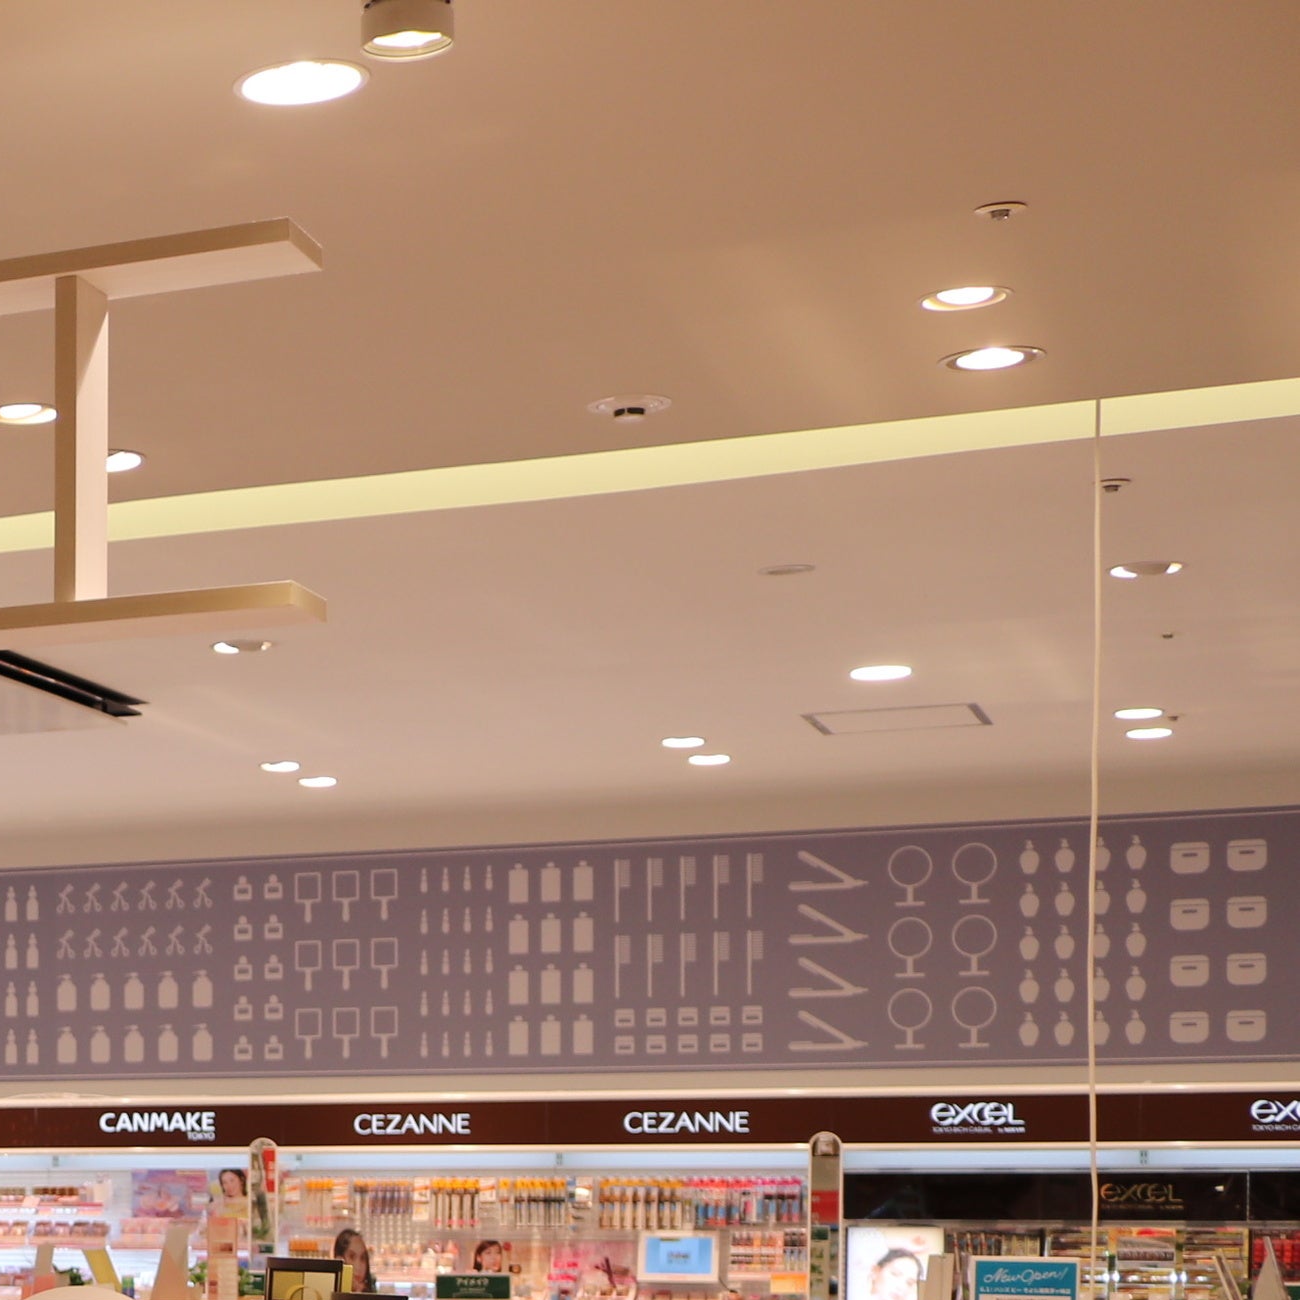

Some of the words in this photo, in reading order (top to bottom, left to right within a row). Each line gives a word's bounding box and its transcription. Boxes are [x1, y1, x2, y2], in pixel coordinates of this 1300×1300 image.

[99, 1111, 216, 1133] CANMAKE
[352, 1112, 472, 1136] CEZANNE
[623, 1111, 750, 1134] CEZANNE
[186, 1130, 216, 1142] TOKYO
[983, 1267, 1021, 1284] New
